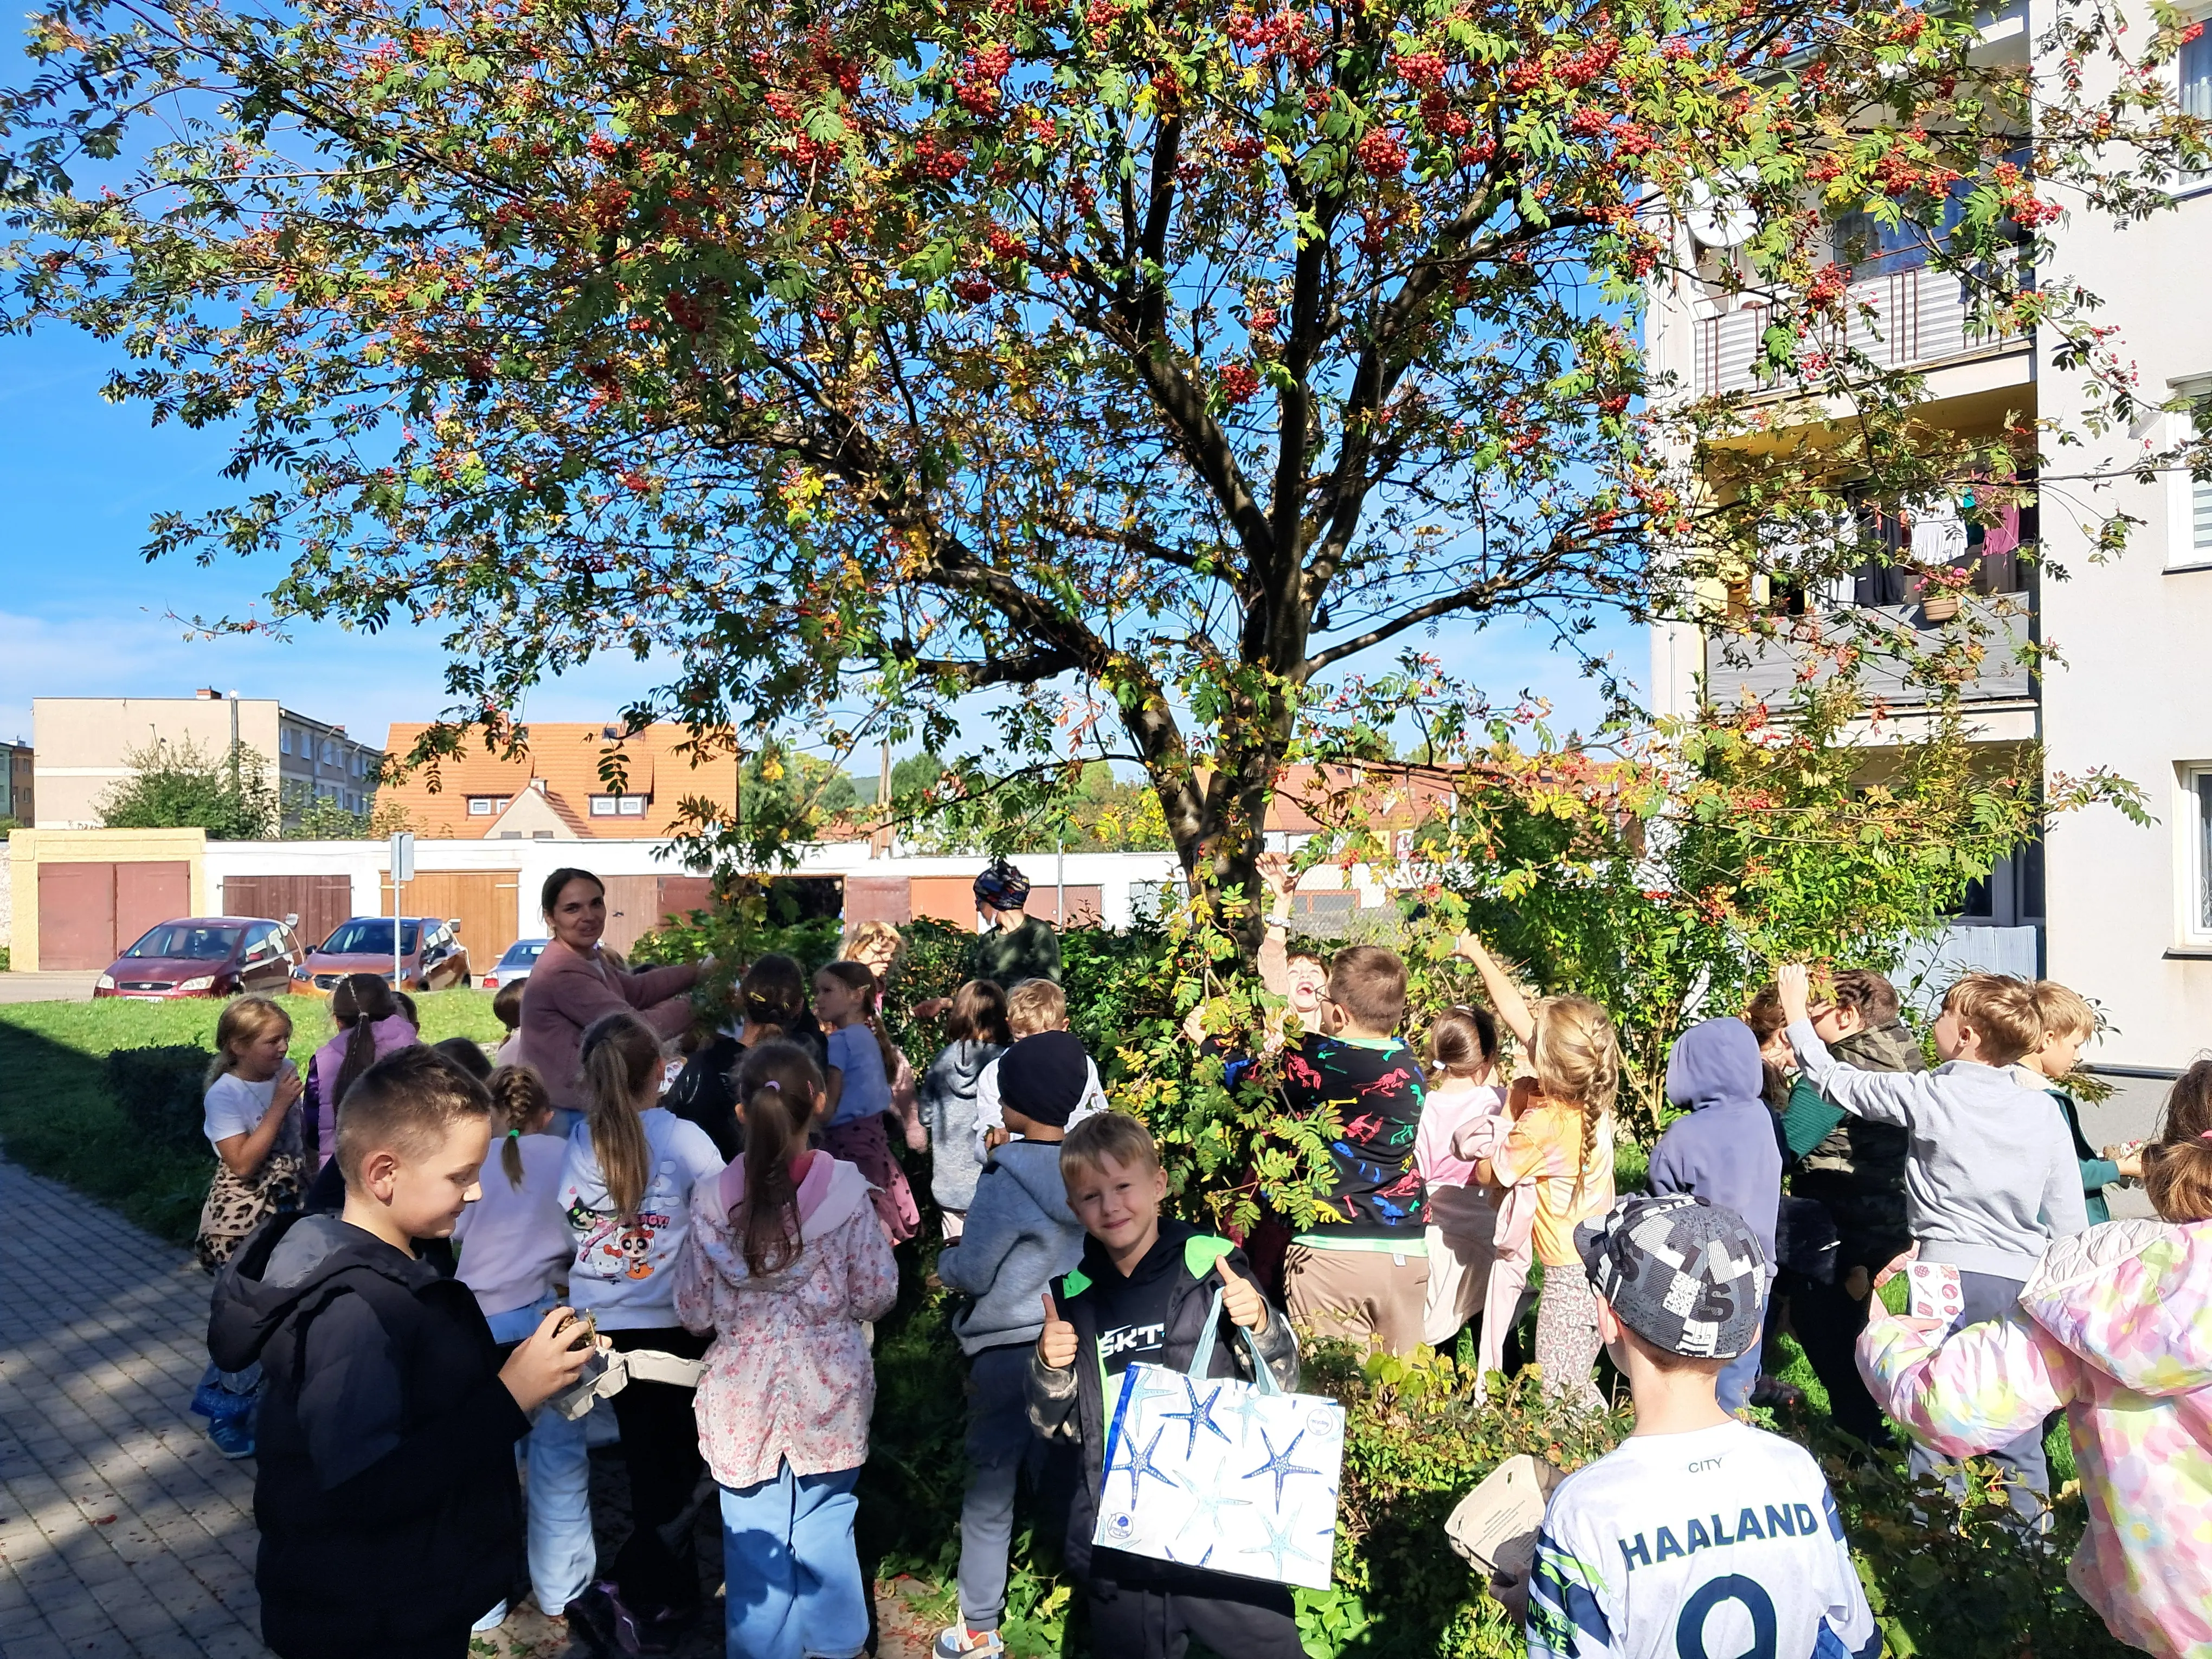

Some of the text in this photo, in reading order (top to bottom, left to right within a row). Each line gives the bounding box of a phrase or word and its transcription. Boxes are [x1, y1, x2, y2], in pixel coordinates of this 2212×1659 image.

[1688, 1457, 1722, 1473] CITY
[1617, 1503, 1818, 1572] HAALAND
[1528, 1598, 1579, 1639] NEXEN
[1534, 1621, 1568, 1654] TIRE
